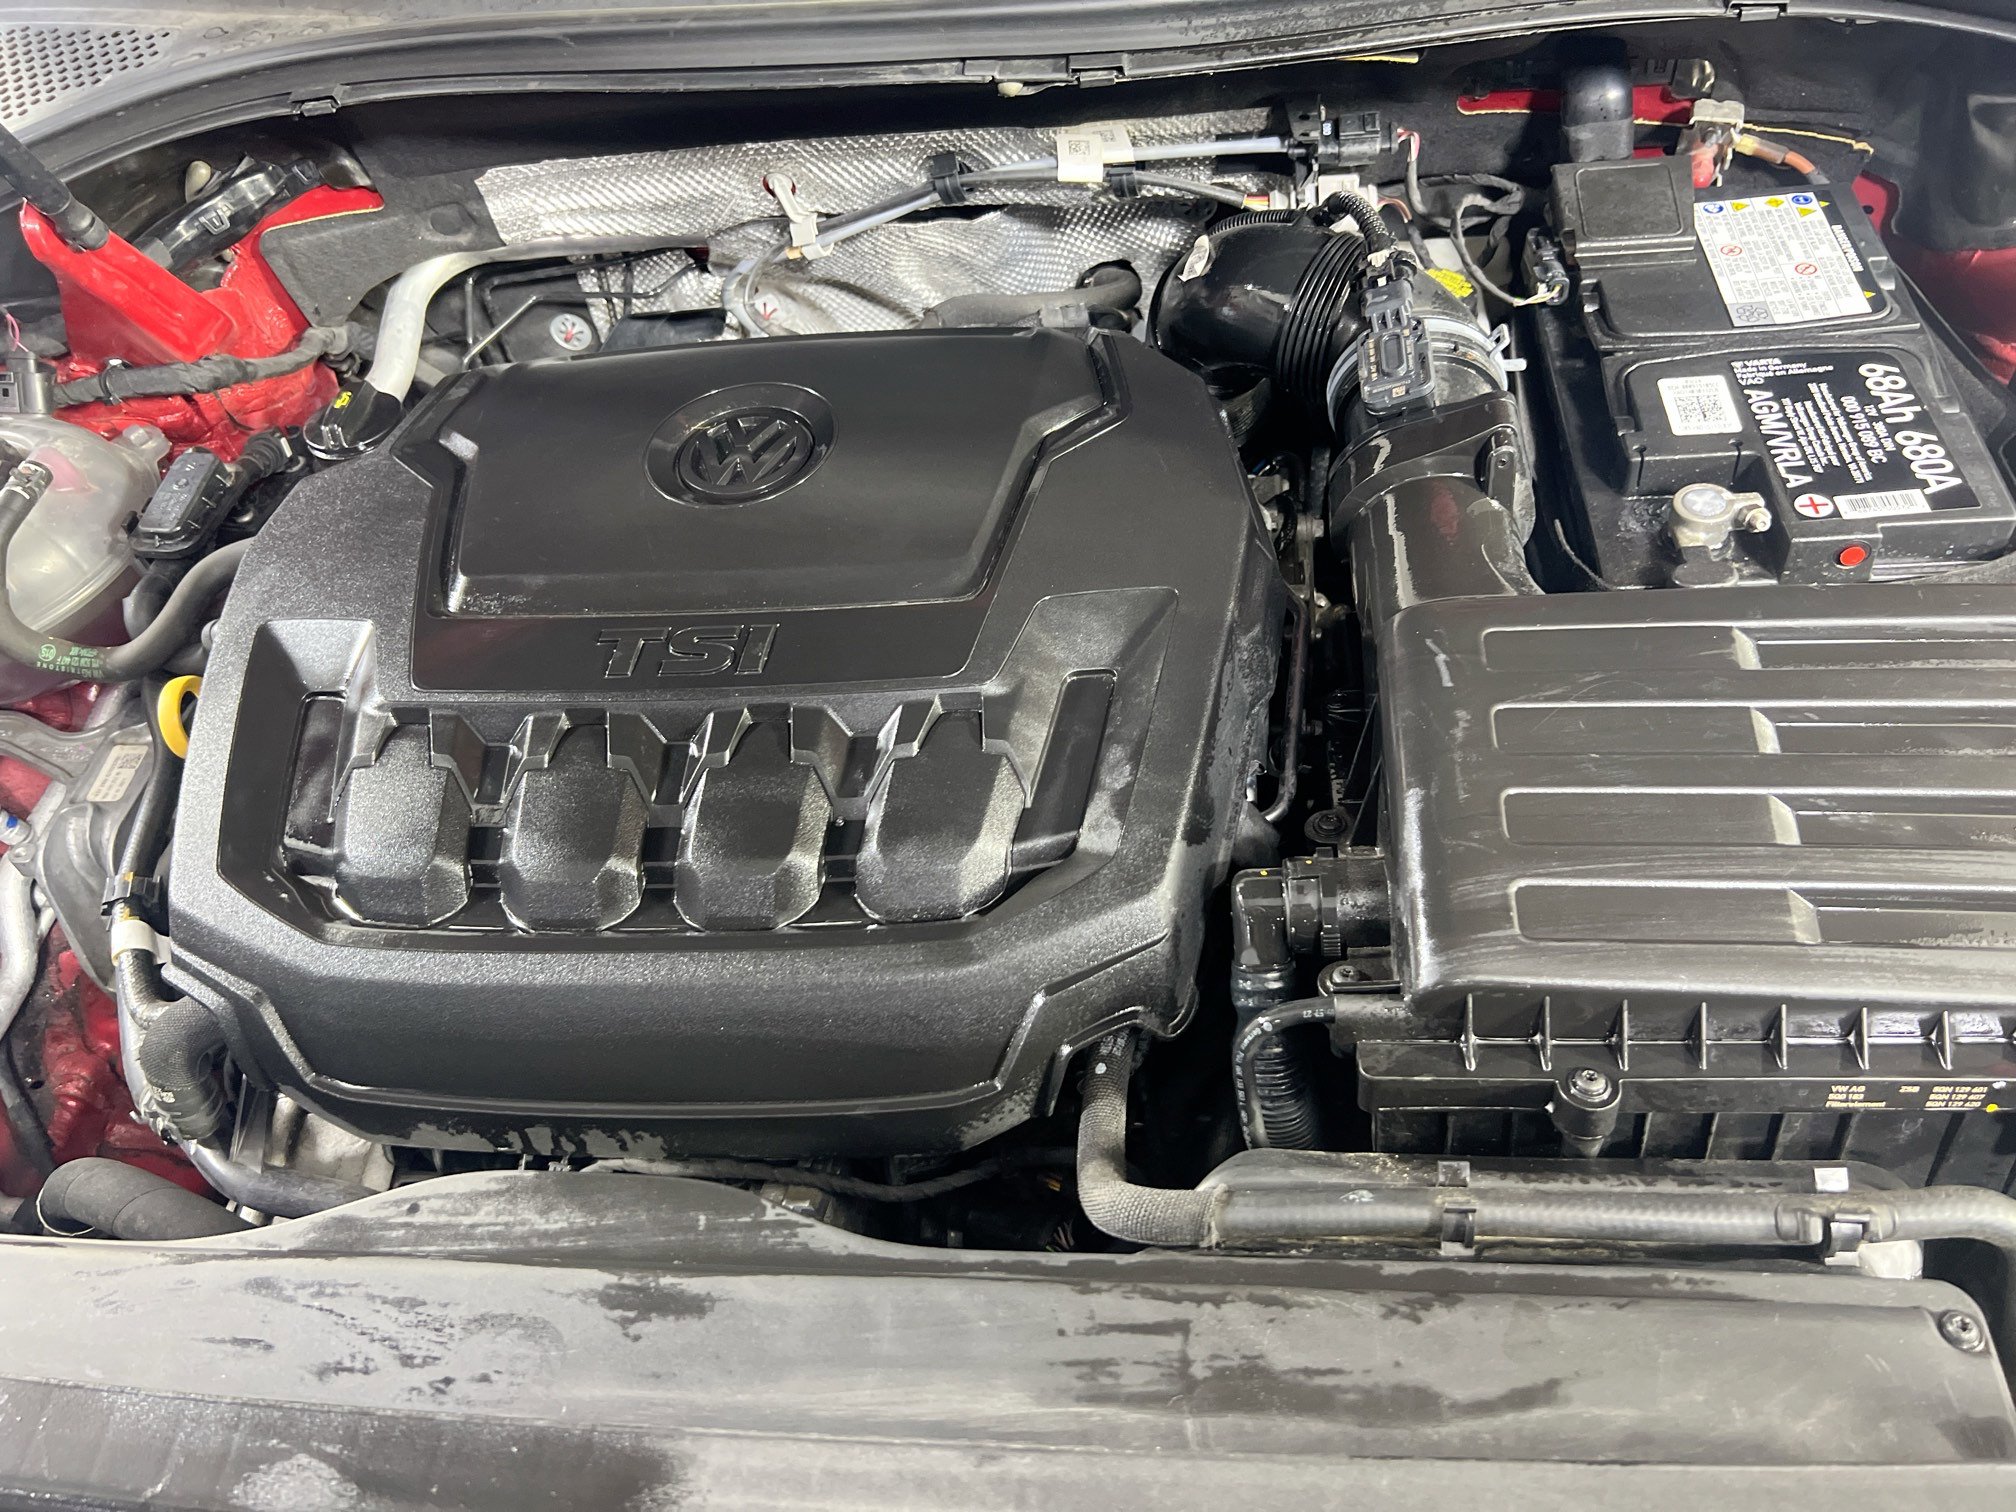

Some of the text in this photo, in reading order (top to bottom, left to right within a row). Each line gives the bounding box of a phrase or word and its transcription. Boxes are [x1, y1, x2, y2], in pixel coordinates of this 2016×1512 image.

[1744, 358, 1781, 366] VARTA
[1768, 363, 1806, 371] Germany
[1788, 365, 1833, 374] Allemagne
[1743, 389, 1813, 488] AGM/VRLA
[1840, 396, 1887, 463] 000 915 089 BC
[1858, 363, 1963, 494] 68Ah 680A
[1863, 405, 1879, 416] 12V
[1880, 438, 1896, 451] DIN
[596, 624, 781, 679] TSI
[1831, 1085, 1866, 1093] VW AG
